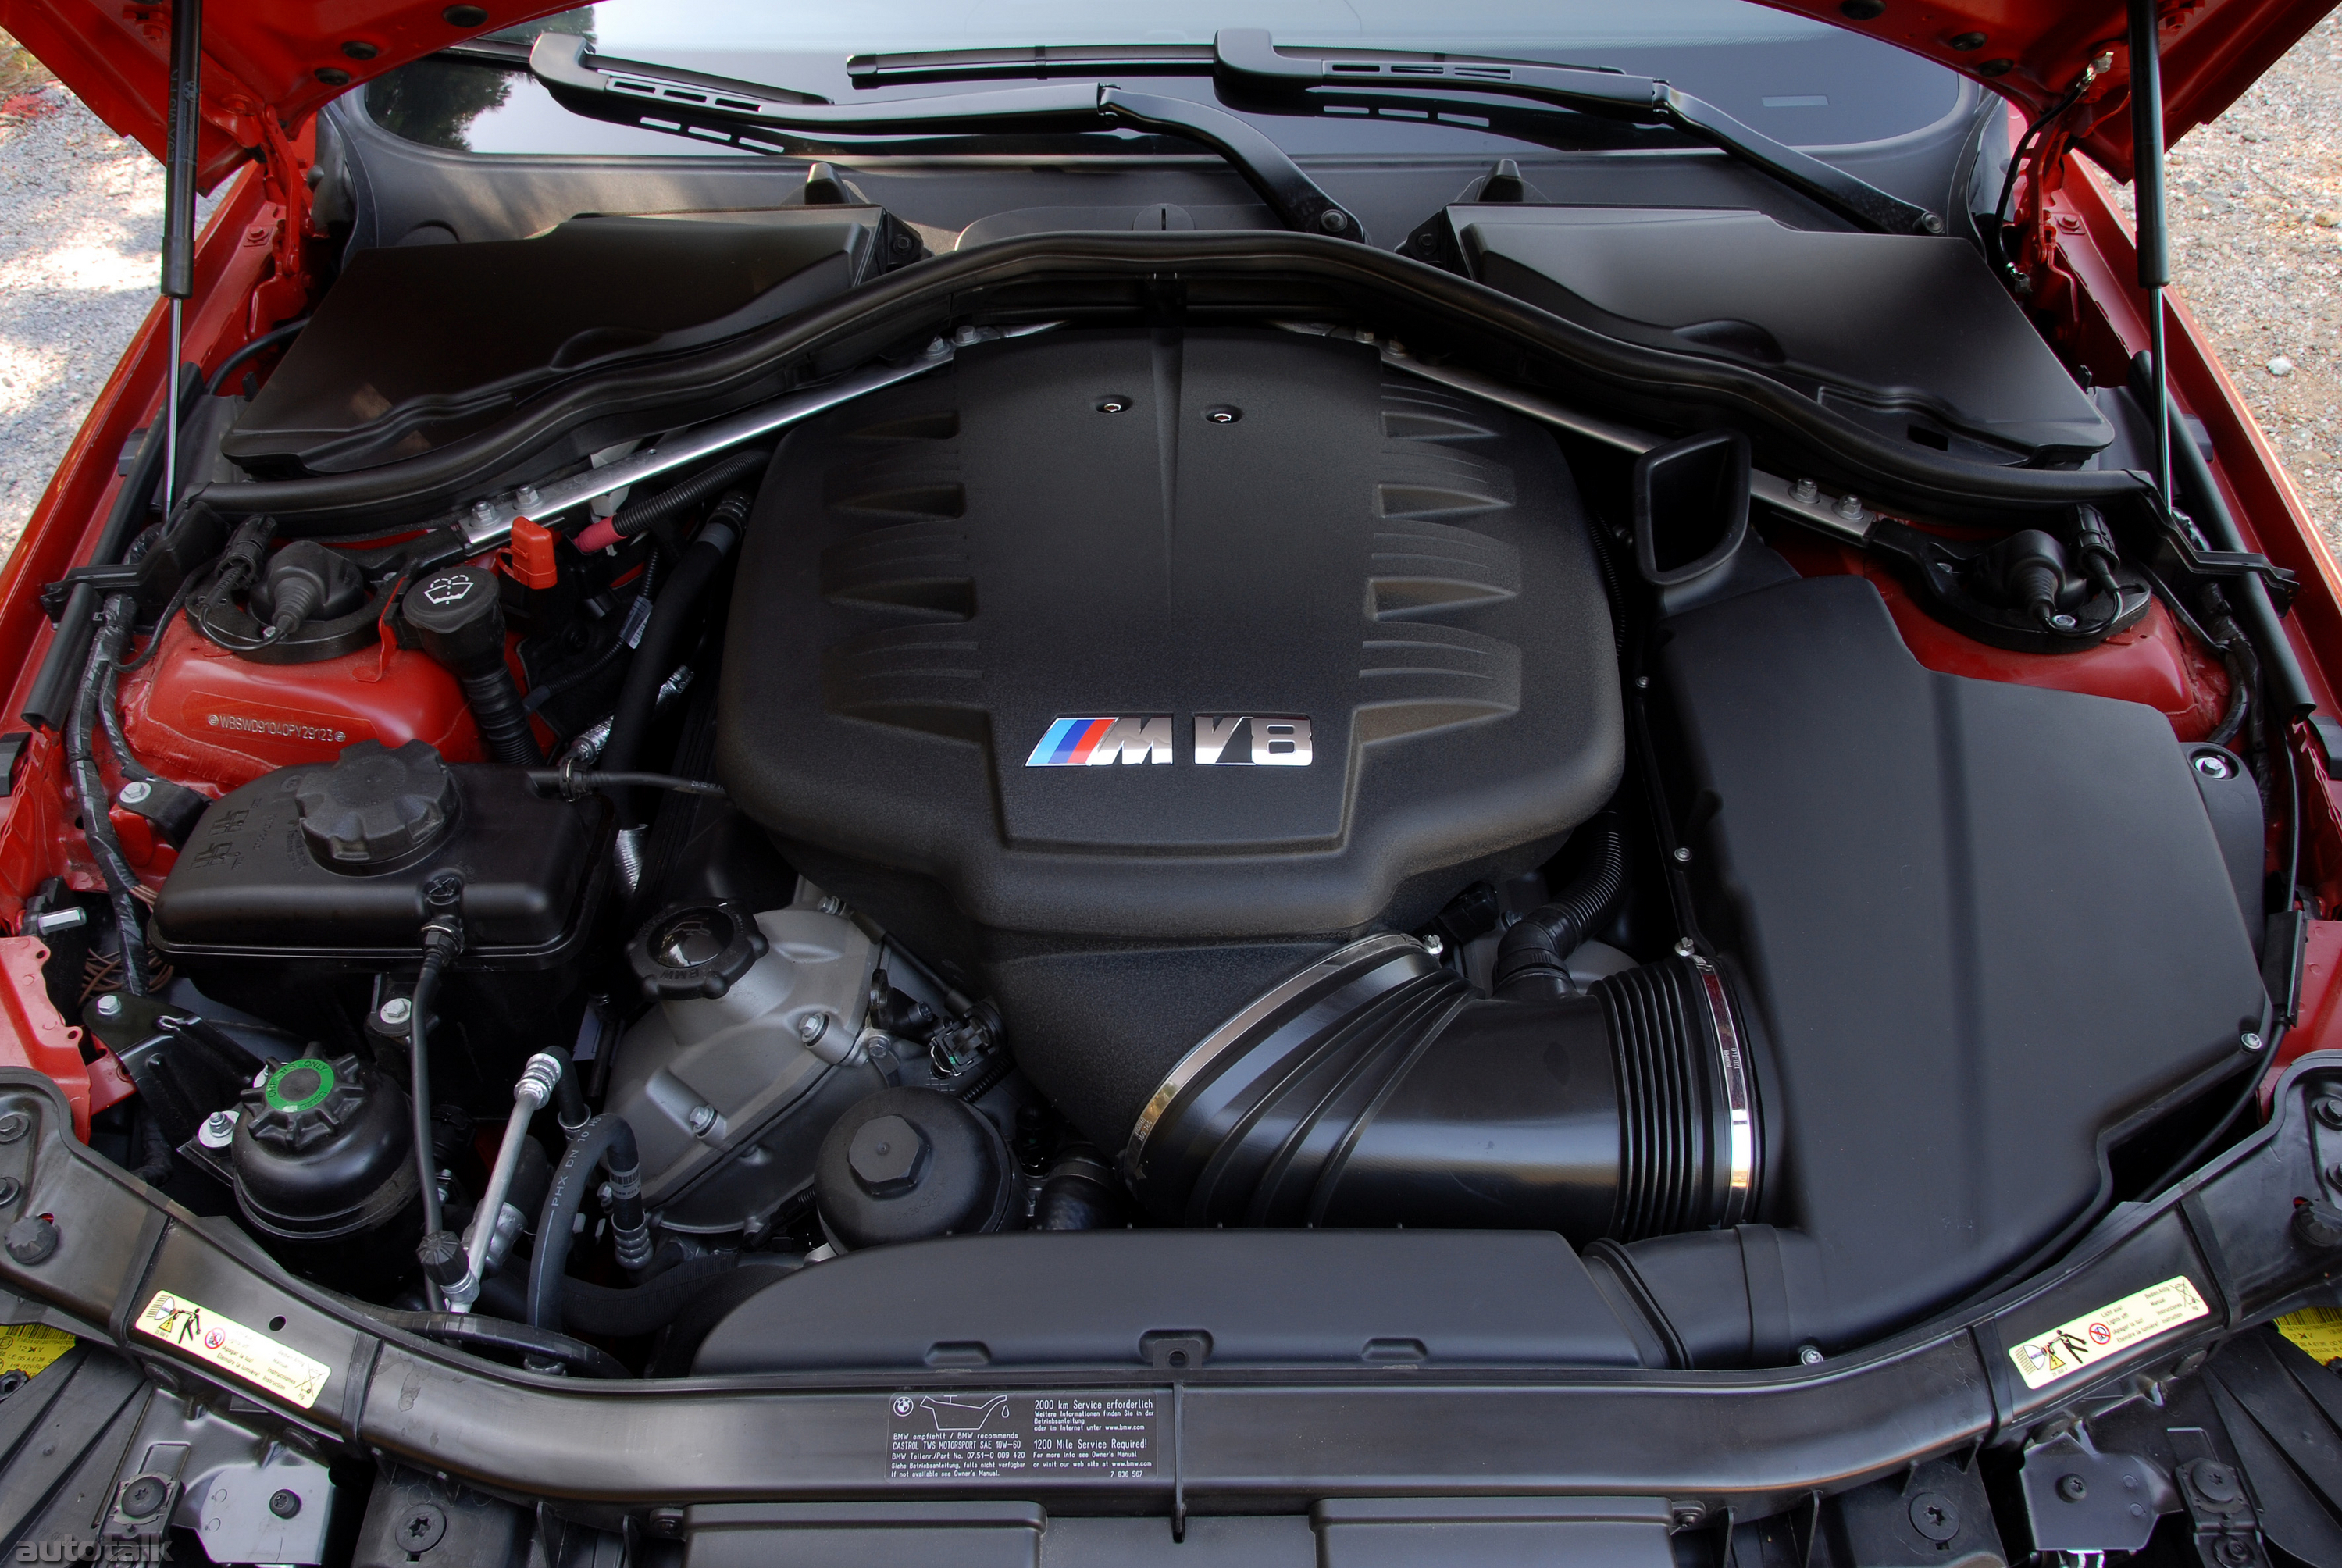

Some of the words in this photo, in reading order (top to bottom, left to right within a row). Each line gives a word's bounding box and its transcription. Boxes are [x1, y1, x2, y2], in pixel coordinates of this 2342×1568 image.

[1085, 717, 1173, 766] M
[1194, 715, 1314, 766] V8
[304, 1060, 328, 1071] ONLY
[551, 1175, 569, 1206] PHX
[565, 1149, 579, 1167] DN
[578, 1131, 590, 1142] 10
[2101, 1308, 2112, 1318] Licht
[267, 1367, 296, 1385] Instrucciones
[263, 1375, 286, 1391] Instruction
[1035, 1400, 1054, 1409] 2000
[1058, 1400, 1069, 1409] km
[1074, 1399, 1102, 1409] Service
[1107, 1399, 1153, 1409] erforderlich
[913, 1432, 946, 1441] empfiehlt
[893, 1441, 919, 1450] CASTROL
[939, 1441, 977, 1449] MOTORSPORT
[980, 1441, 992, 1449] SAE
[996, 1441, 1021, 1449] 10W-60
[1034, 1439, 1052, 1449] 1200
[1057, 1439, 1073, 1449] Mile
[1078, 1438, 1107, 1449] Service
[1111, 1438, 1147, 1450] Required!
